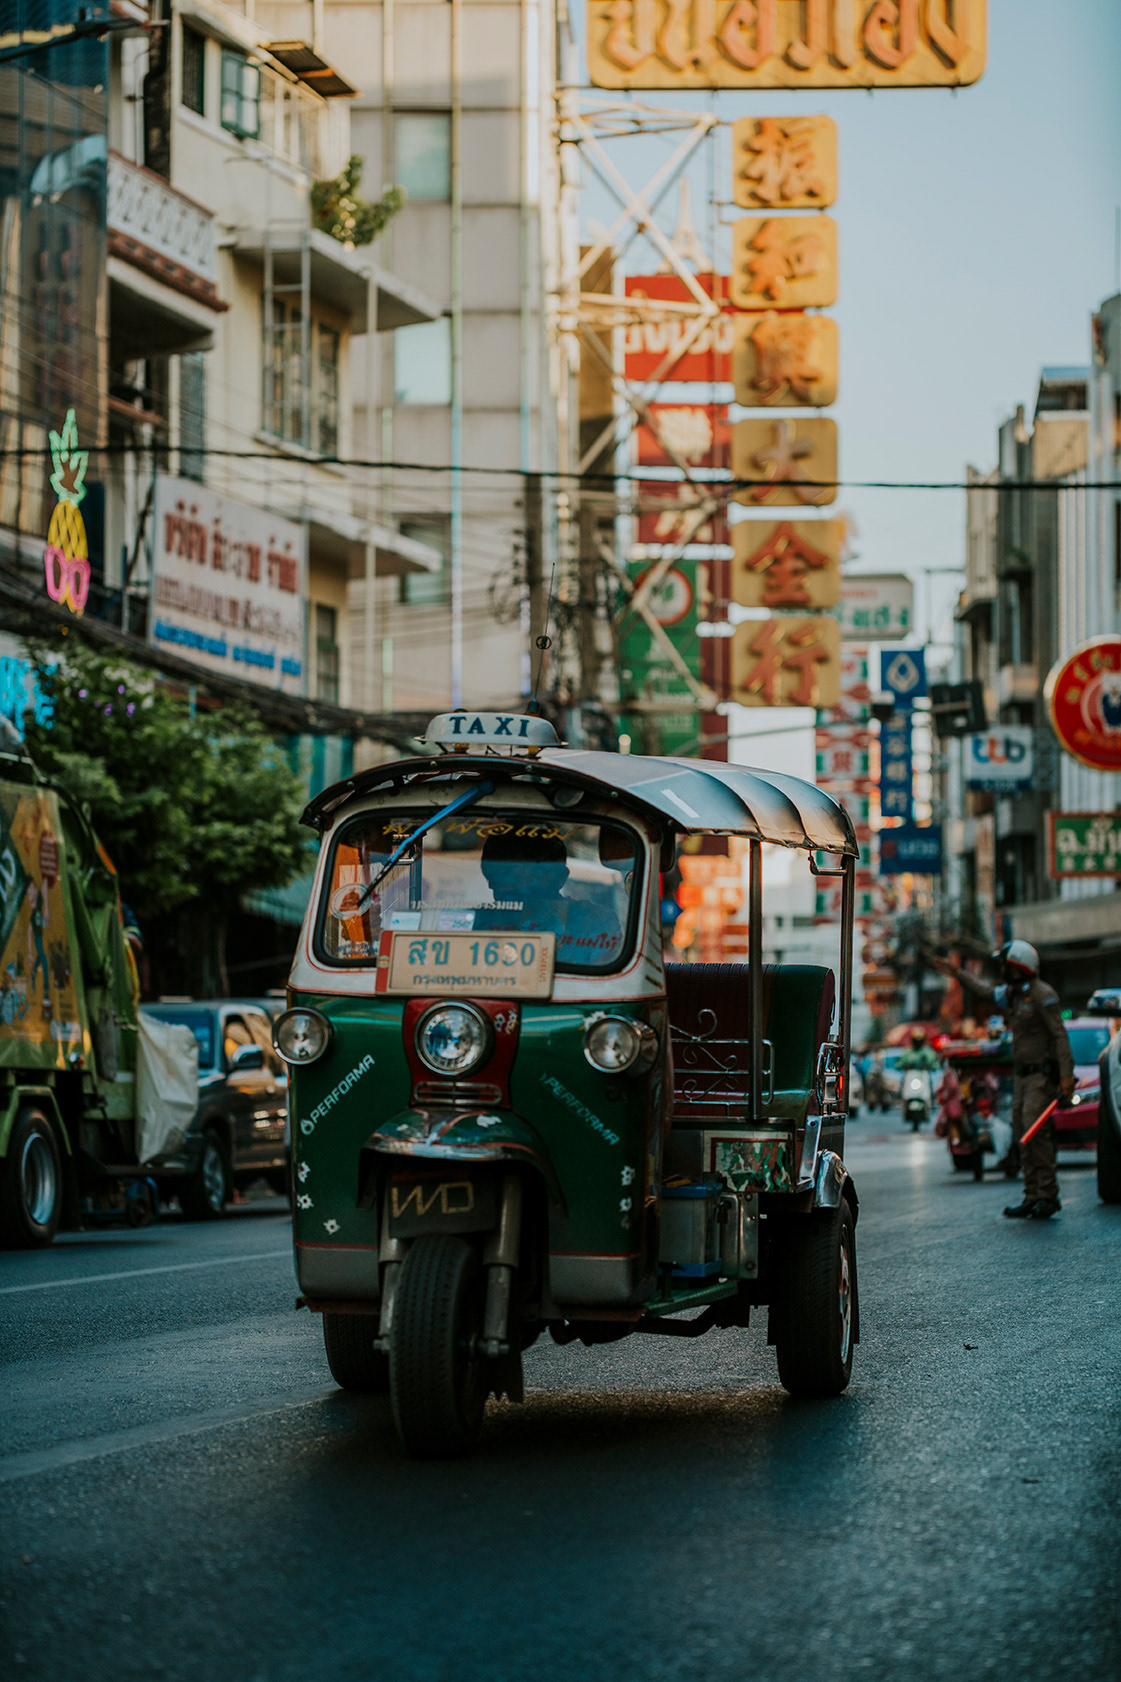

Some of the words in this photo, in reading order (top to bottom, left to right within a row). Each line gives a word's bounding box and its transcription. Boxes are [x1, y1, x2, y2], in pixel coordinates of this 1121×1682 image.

[449, 716, 529, 737] TAXI
[408, 938, 450, 966] สข
[310, 1054, 375, 1124] PERFORMA
[544, 1076, 620, 1145] PERFORMA
